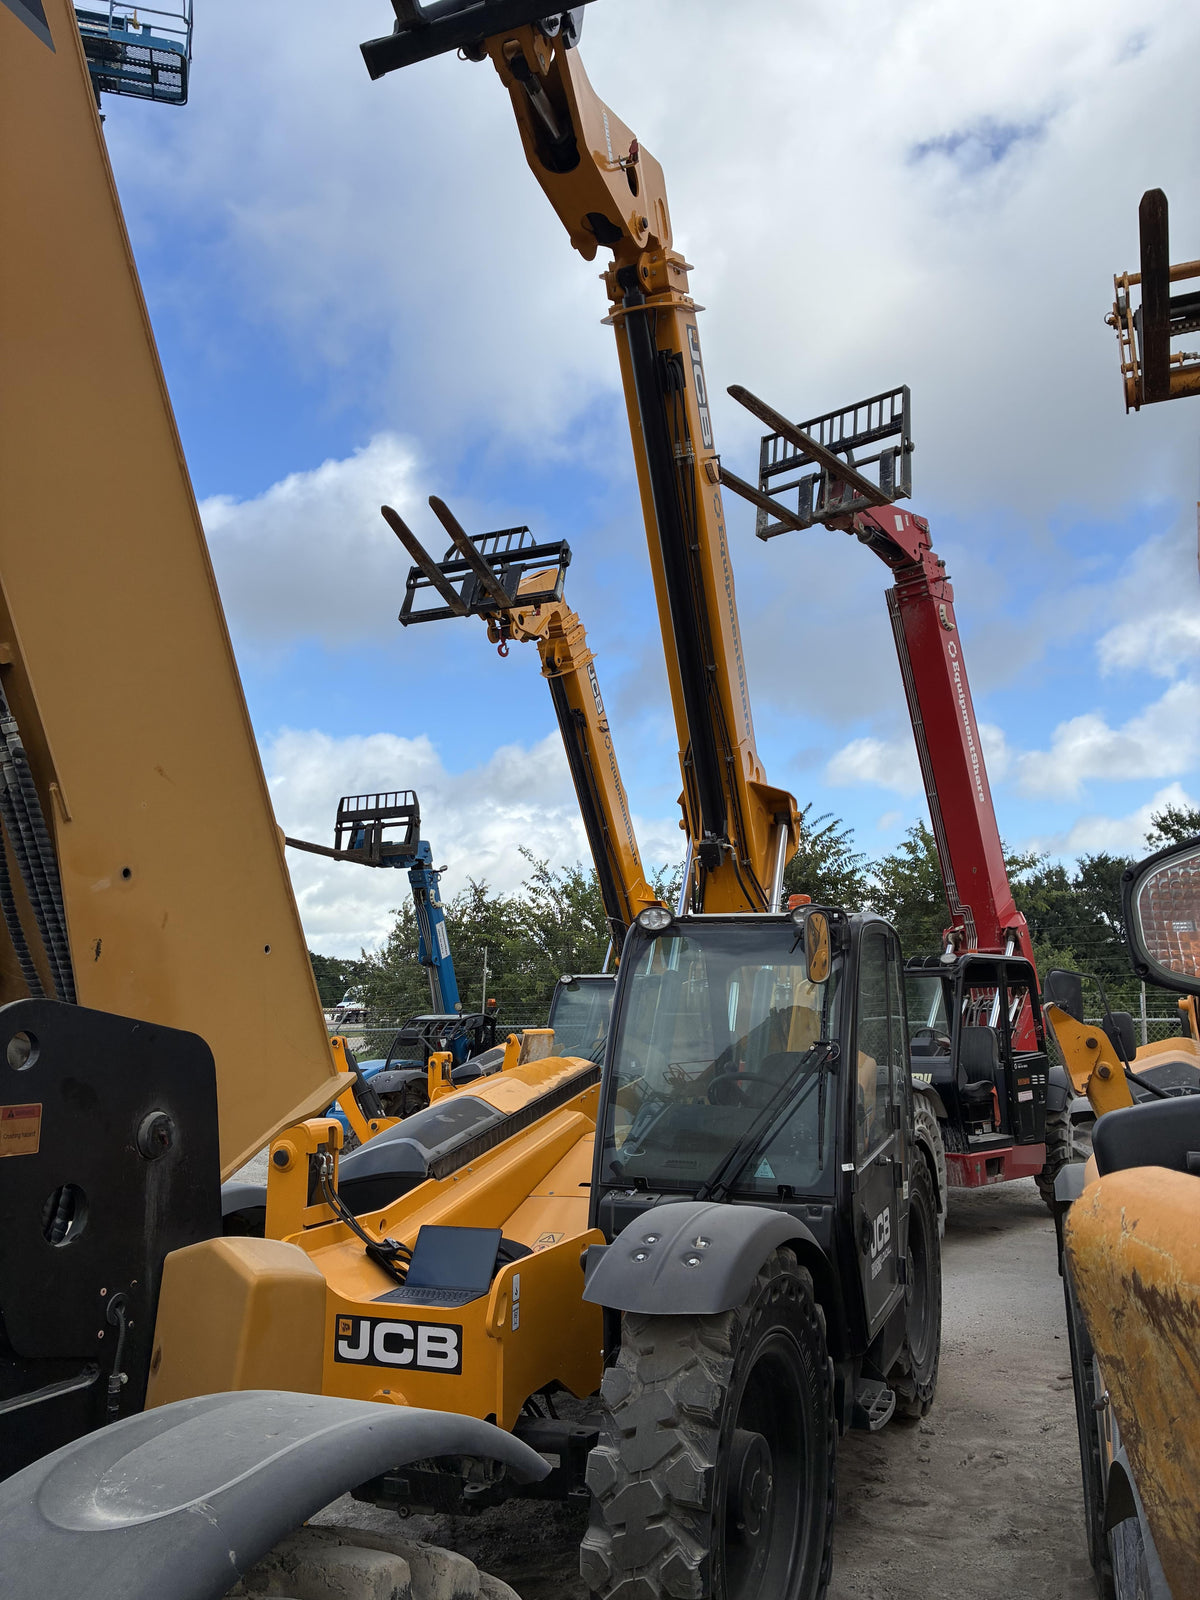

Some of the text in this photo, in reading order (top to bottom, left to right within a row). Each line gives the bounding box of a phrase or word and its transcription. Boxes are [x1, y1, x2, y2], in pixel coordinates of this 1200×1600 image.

[687, 327, 712, 449] JCB
[717, 524, 753, 737] EquipmentShare
[587, 664, 604, 714] JCB
[952, 661, 985, 803] EquipmentShare
[870, 1206, 891, 1258] JCB
[338, 1319, 459, 1370] JCB
